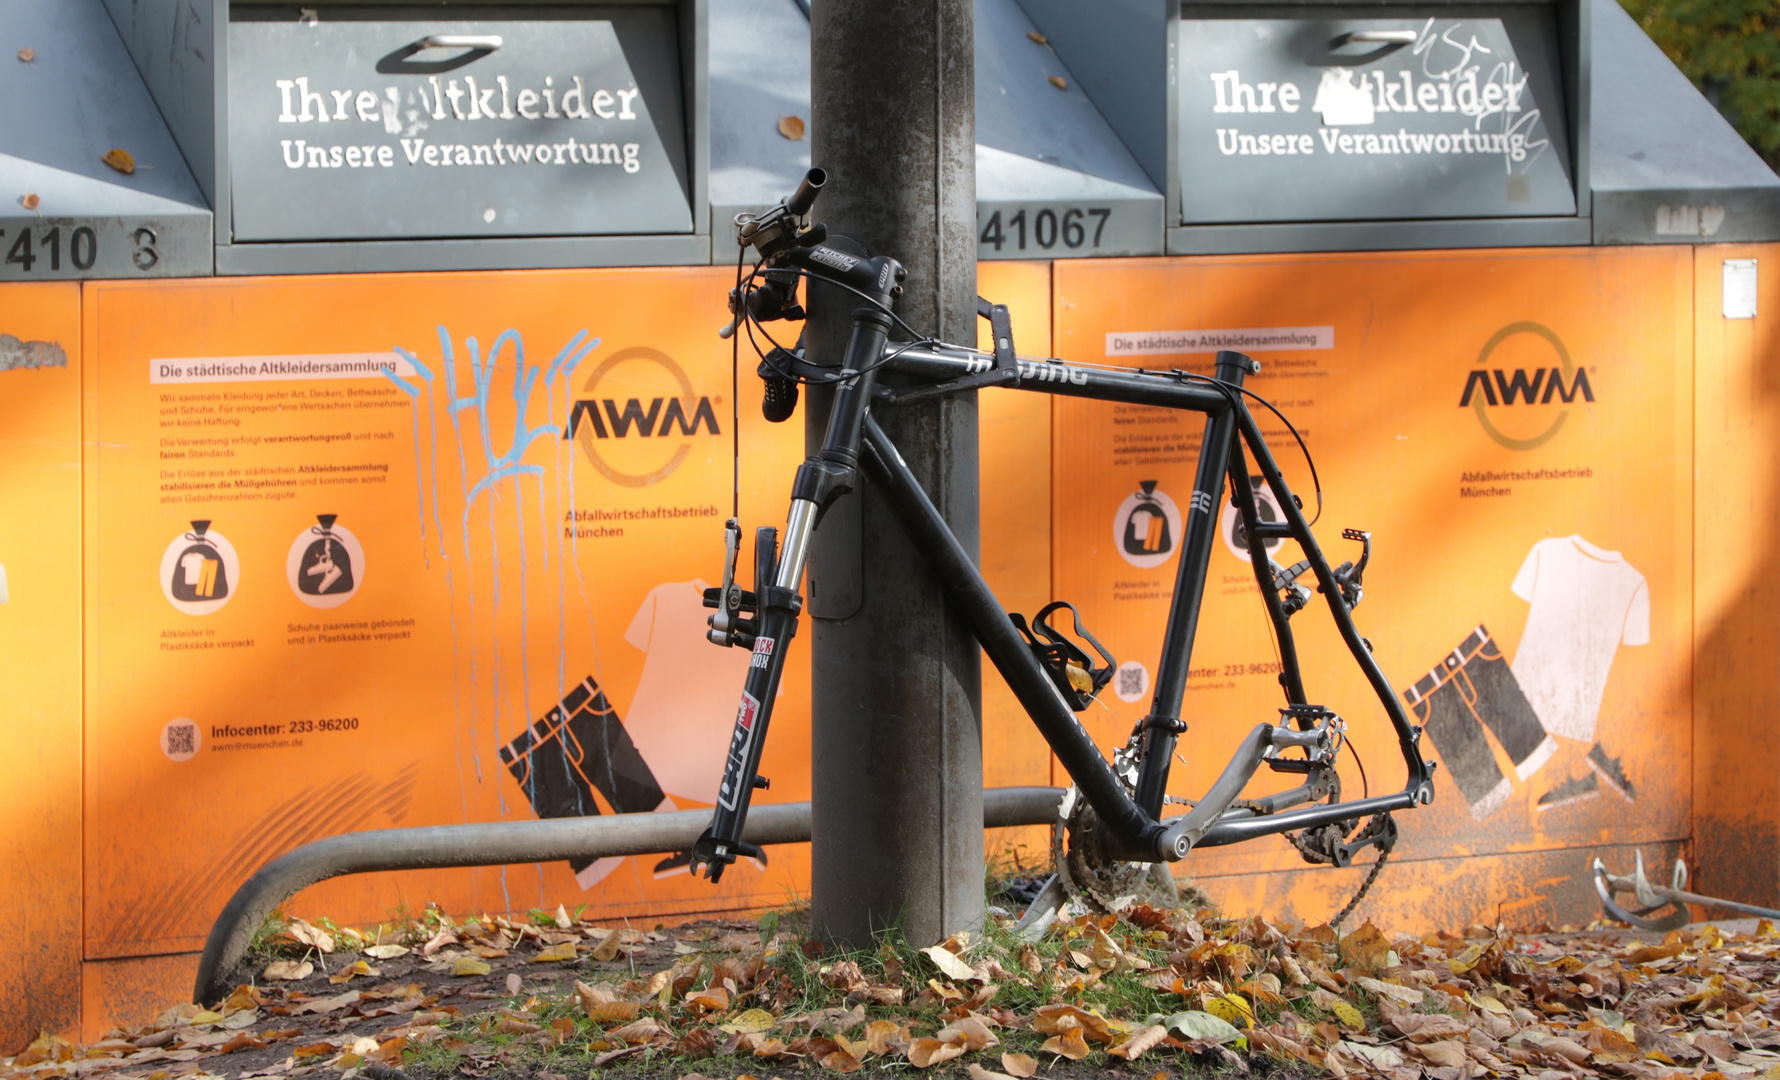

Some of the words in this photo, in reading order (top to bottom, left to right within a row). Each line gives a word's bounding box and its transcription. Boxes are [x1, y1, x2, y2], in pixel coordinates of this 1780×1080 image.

[276, 77, 380, 122] Ihre
[405, 75, 638, 121] ltkleider
[1210, 70, 1300, 113] Ihre
[1312, 70, 1521, 113] kleider
[1216, 129, 1314, 155] Unsere
[1319, 128, 1527, 161] Verantwortung
[281, 140, 394, 168] Unsere
[400, 137, 640, 173] Verantwortung
[977, 208, 1111, 251] 41067
[0, 227, 97, 271] 410
[1114, 337, 1133, 350] Die
[1137, 335, 1197, 349] städtische
[1199, 332, 1317, 349] Altkleidersammlung
[159, 365, 182, 378] Die
[186, 362, 256, 377] städtische
[259, 359, 397, 375] Altkleidersammlung
[160, 393, 176, 403] Wir
[179, 392, 221, 402] sammeln
[223, 390, 264, 402] Kleidung
[266, 390, 288, 402] jeder
[291, 389, 307, 400] Art,
[310, 388, 344, 401] Decken,
[347, 387, 397, 398] Bettwäsche
[1459, 367, 1595, 407] AWM
[160, 405, 177, 416] und
[180, 404, 216, 415] Schuhe.
[219, 402, 233, 414] Für
[300, 400, 351, 411] Wertsachen
[353, 398, 410, 410] übernehmen
[160, 419, 174, 428] wir
[177, 417, 201, 427] keine
[204, 416, 242, 428] Haftung.
[562, 396, 721, 440] AWM
[160, 437, 175, 448] Die
[177, 436, 229, 448] Verwertung
[231, 434, 262, 446] erfolgt
[264, 432, 351, 445] verantwortungsvoll
[354, 430, 371, 441] und
[373, 430, 394, 440] nach
[160, 449, 186, 460] fairen
[188, 448, 237, 459] Standards.
[160, 469, 175, 480] Die
[177, 468, 207, 479] Erlöse
[208, 469, 225, 478] aus
[227, 466, 242, 477] der
[244, 464, 295, 476] städtischen
[298, 462, 388, 475] Altkleidersammlung
[1461, 466, 1593, 483] Abfallwirtschaftsbetrieb
[160, 480, 215, 492] stabilisieren
[218, 479, 232, 490] die
[234, 476, 297, 490] Müllgebühren
[299, 476, 317, 487] und
[320, 475, 359, 486] kommen
[361, 474, 386, 485] somit
[1461, 486, 1511, 498] München
[160, 494, 183, 505] allen
[184, 492, 263, 504] Gebührenzahlern
[265, 491, 297, 503] zugute.
[565, 504, 718, 522] Abfallwirtschaftsbetrieb
[565, 525, 624, 539] München
[160, 629, 204, 640] Altkleider
[206, 628, 214, 638] in
[287, 623, 320, 634] Schuhe
[323, 620, 368, 633] paarweise
[370, 618, 415, 631] gebündelt
[160, 640, 214, 652] Plastiksäcke
[217, 637, 254, 650] verpackt
[287, 635, 305, 646] und
[307, 634, 316, 645] in
[318, 631, 371, 644] Plastiksäcke
[374, 630, 411, 643] verpackt
[754, 638, 773, 655] OCK
[750, 654, 769, 670] HOX
[1187, 666, 1221, 680] enter:
[211, 723, 286, 738] Infocenter:
[289, 718, 359, 734] 233-96200
[211, 738, 303, 752] awm@muenchen.de
